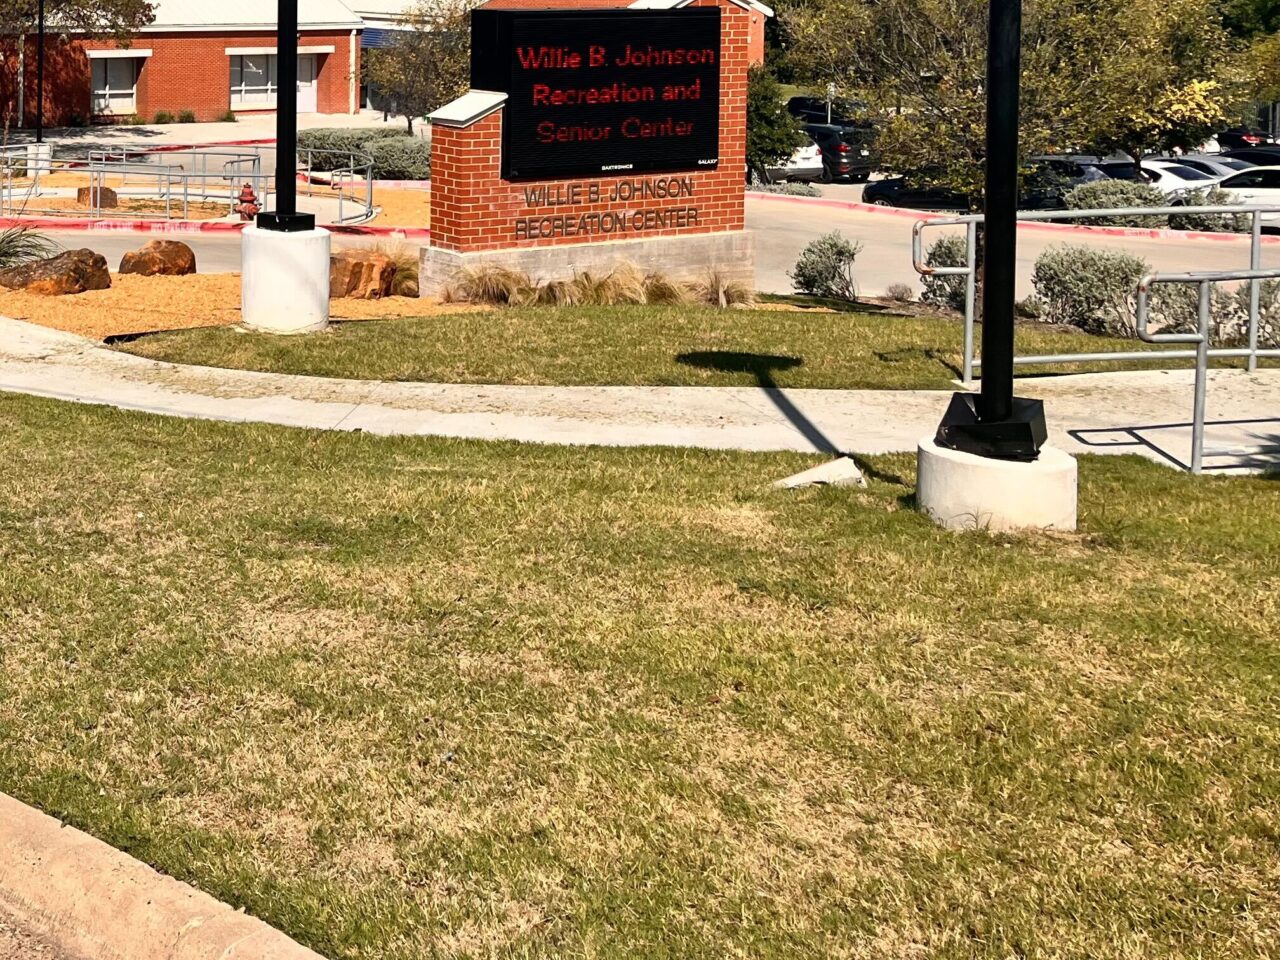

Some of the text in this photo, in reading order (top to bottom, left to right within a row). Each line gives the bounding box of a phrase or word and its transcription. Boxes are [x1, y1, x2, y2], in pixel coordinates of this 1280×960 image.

[516, 44, 715, 69] Willie B. Johnson
[532, 77, 701, 106] Recreation and
[536, 117, 695, 144] Senior Center
[524, 178, 693, 208] WILLIE B. JOHNSON
[515, 207, 699, 240] RECREATION CENTER
